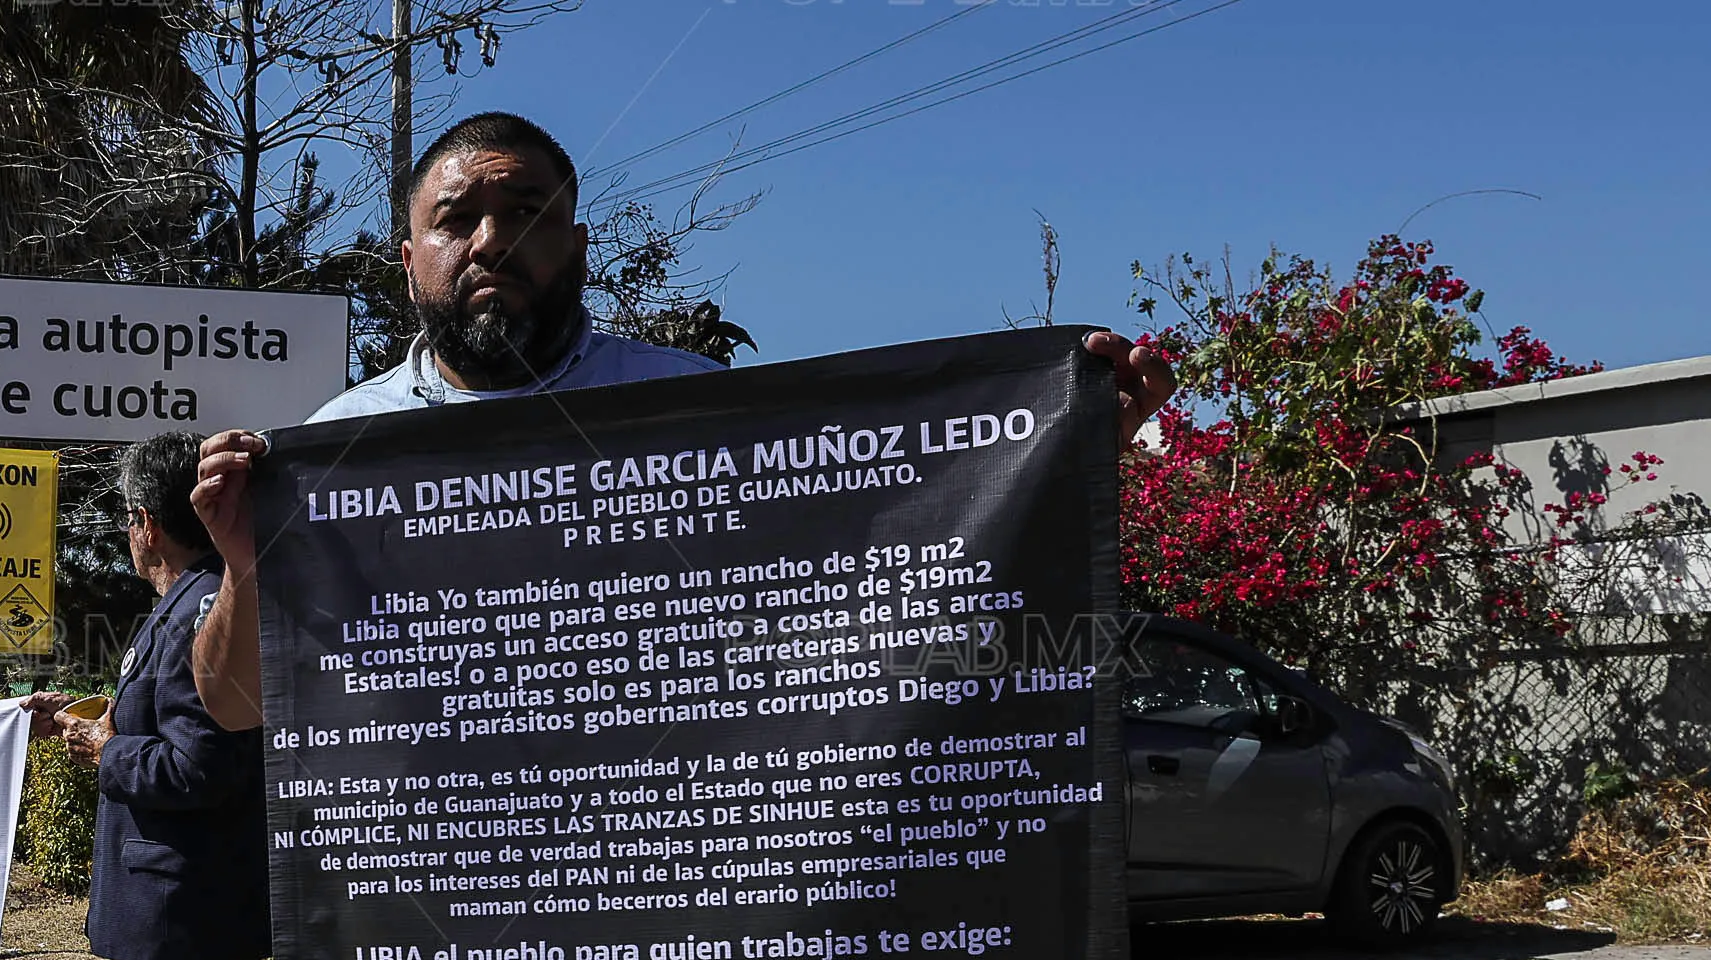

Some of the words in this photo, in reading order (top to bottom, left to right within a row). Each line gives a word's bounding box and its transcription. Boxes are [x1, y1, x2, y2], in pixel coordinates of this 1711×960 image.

[43, 314, 287, 370] autopista
[54, 380, 197, 421] cuota
[309, 486, 402, 521] LIBIA
[416, 464, 576, 511] DENNISE
[590, 447, 738, 491] GARCIA
[753, 425, 904, 473] MUÑOZ
[921, 409, 1034, 455] LEDO
[405, 508, 531, 537] EMPLEADA
[540, 502, 585, 524] DEL
[593, 490, 688, 518] PUEBLO
[698, 485, 730, 506] DE
[739, 464, 922, 501] GUANAJUATO.
[372, 592, 429, 615] Libia
[438, 589, 467, 610] Yo
[475, 578, 579, 606] también
[589, 572, 669, 602] quiero
[680, 570, 711, 588] un
[722, 557, 813, 584] rancho
[823, 552, 855, 574] de
[865, 545, 910, 572] $19
[922, 537, 964, 562] m2
[279, 779, 333, 798] LIBIA:
[340, 777, 380, 794] Esta
[387, 778, 398, 796] y
[406, 777, 430, 789] no
[438, 772, 484, 789] otra,
[492, 772, 512, 785] es
[520, 765, 541, 783] tú
[549, 757, 679, 786] oportunidad
[687, 760, 699, 779] y
[707, 755, 725, 772] la
[733, 752, 758, 770] de
[765, 748, 788, 767] tú
[797, 743, 896, 770] gobierno
[905, 738, 932, 757] de
[941, 733, 1057, 754] demostrar
[1066, 727, 1085, 746] al
[275, 832, 293, 848] NI
[301, 825, 401, 846] CÓMPLICE,
[408, 824, 428, 841] NI
[437, 818, 546, 839] ENCUBRES
[554, 816, 594, 834] LAS
[601, 809, 705, 831] TRANZAS
[713, 806, 742, 825] DE
[750, 800, 834, 822] SINHUE
[842, 799, 888, 816] esta
[897, 799, 920, 813] es
[929, 795, 952, 811] tu
[961, 782, 1102, 813] oportunidad
